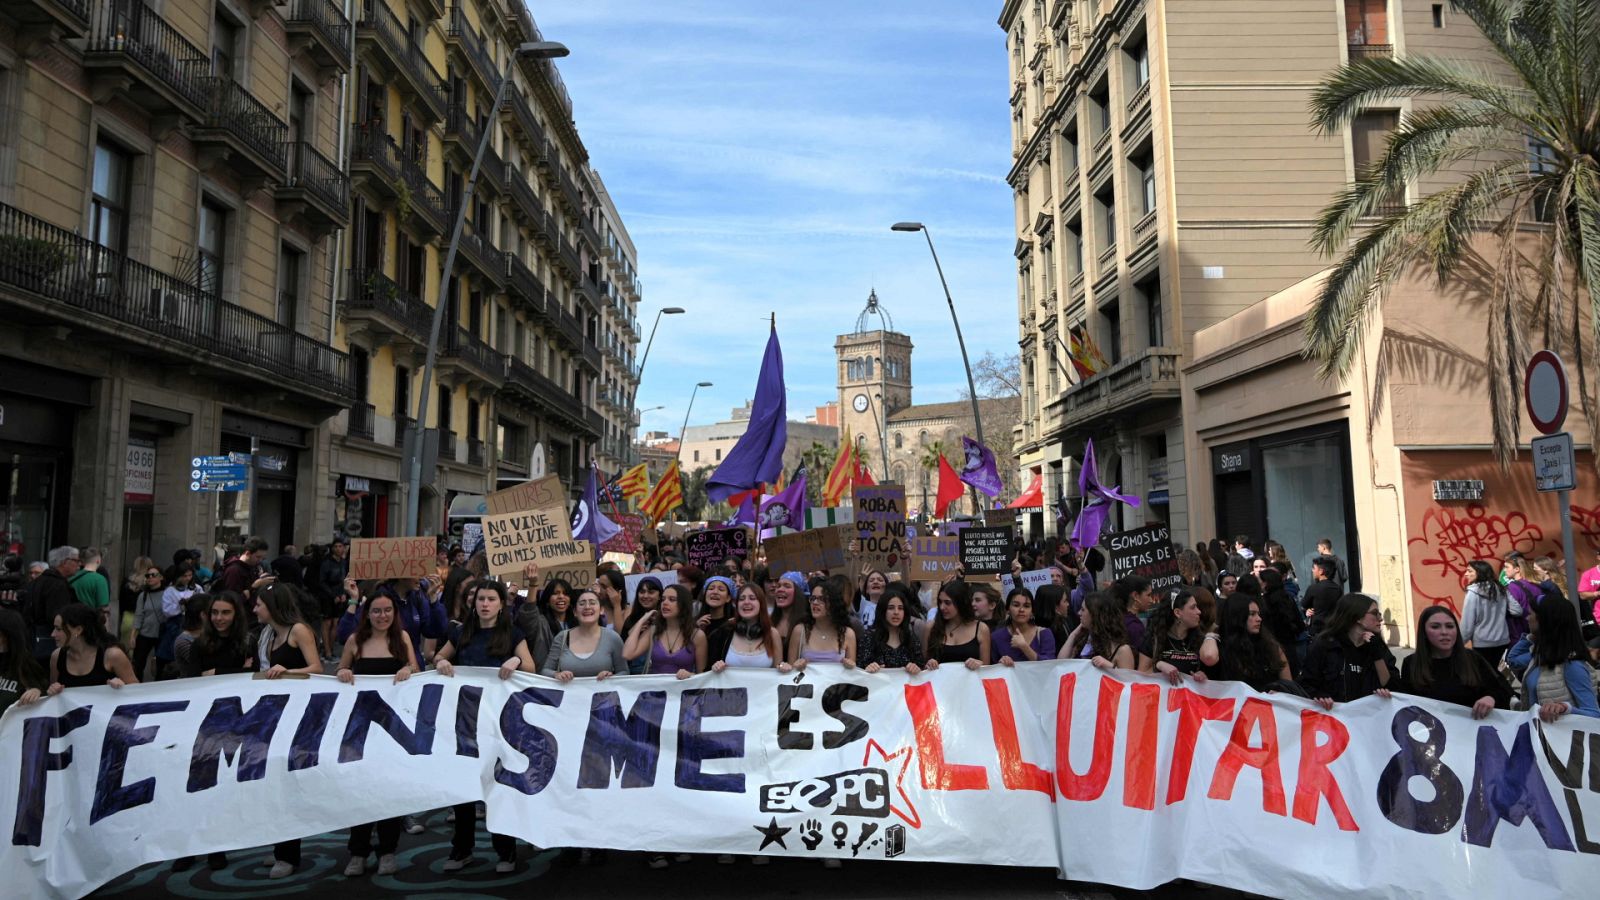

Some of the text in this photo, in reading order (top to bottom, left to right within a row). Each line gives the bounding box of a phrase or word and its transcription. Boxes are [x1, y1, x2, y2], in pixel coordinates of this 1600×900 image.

[1221, 454, 1242, 469] Shana
[860, 497, 899, 514] ROBA
[487, 513, 550, 537] NO VINE
[527, 524, 558, 544] VINE
[885, 521, 906, 538] NO
[354, 538, 437, 560] IT'S A DRESS
[856, 537, 902, 553] TOCA
[1111, 528, 1169, 551] SOMOS LAS
[492, 541, 585, 567] CON MIS HERMANAS
[1115, 552, 1153, 570] NIETAS
[1157, 547, 1171, 560] DE
[354, 559, 427, 579] NOT A YES
[922, 561, 938, 571] NO
[12, 671, 1577, 853] FEMINISME ÉS LLUITAR 8M
